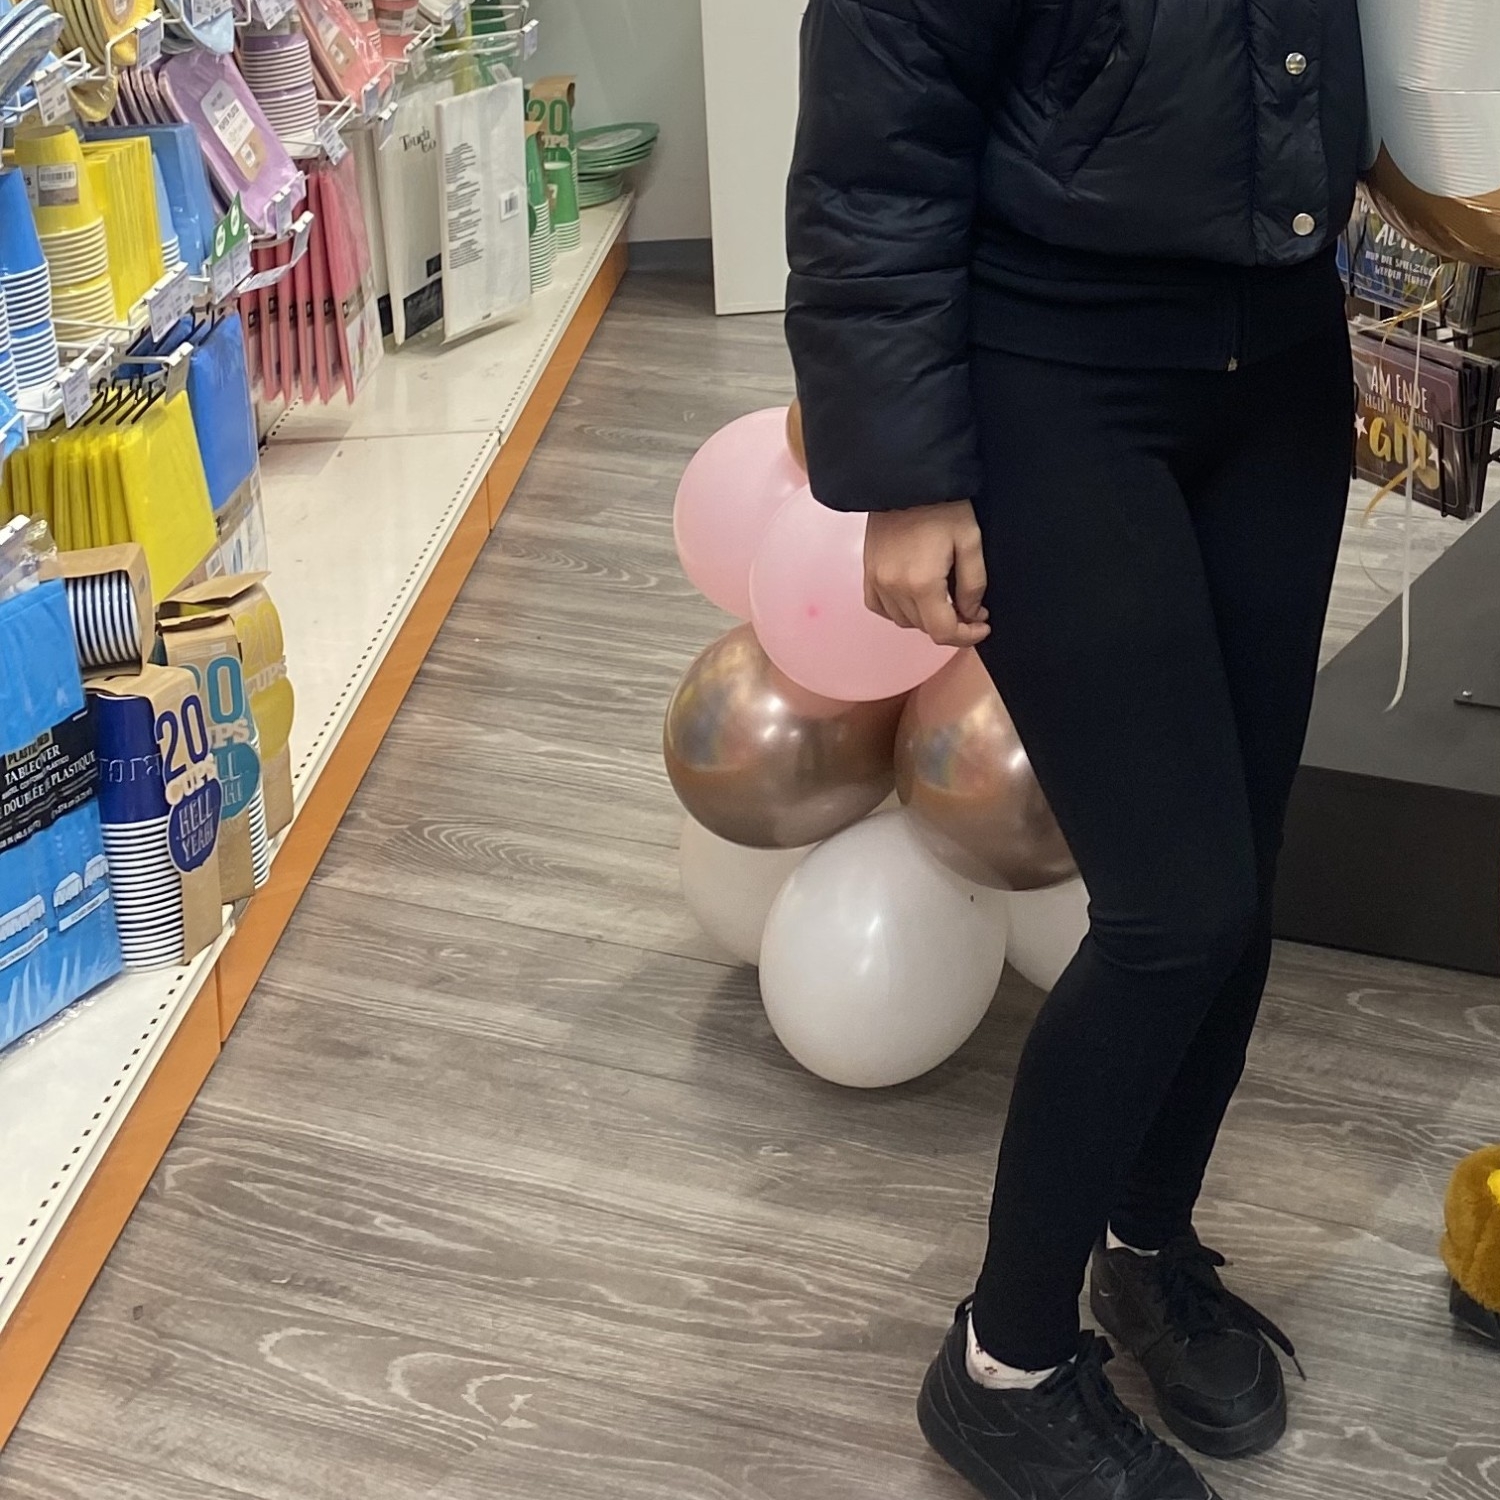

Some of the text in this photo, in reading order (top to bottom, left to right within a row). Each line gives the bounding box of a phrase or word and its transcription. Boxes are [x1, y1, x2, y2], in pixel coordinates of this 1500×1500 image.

[527, 99, 569, 136] 20
[1371, 364, 1429, 414] AM ENDE
[156, 695, 209, 782] 20
[178, 788, 213, 838] HELL
